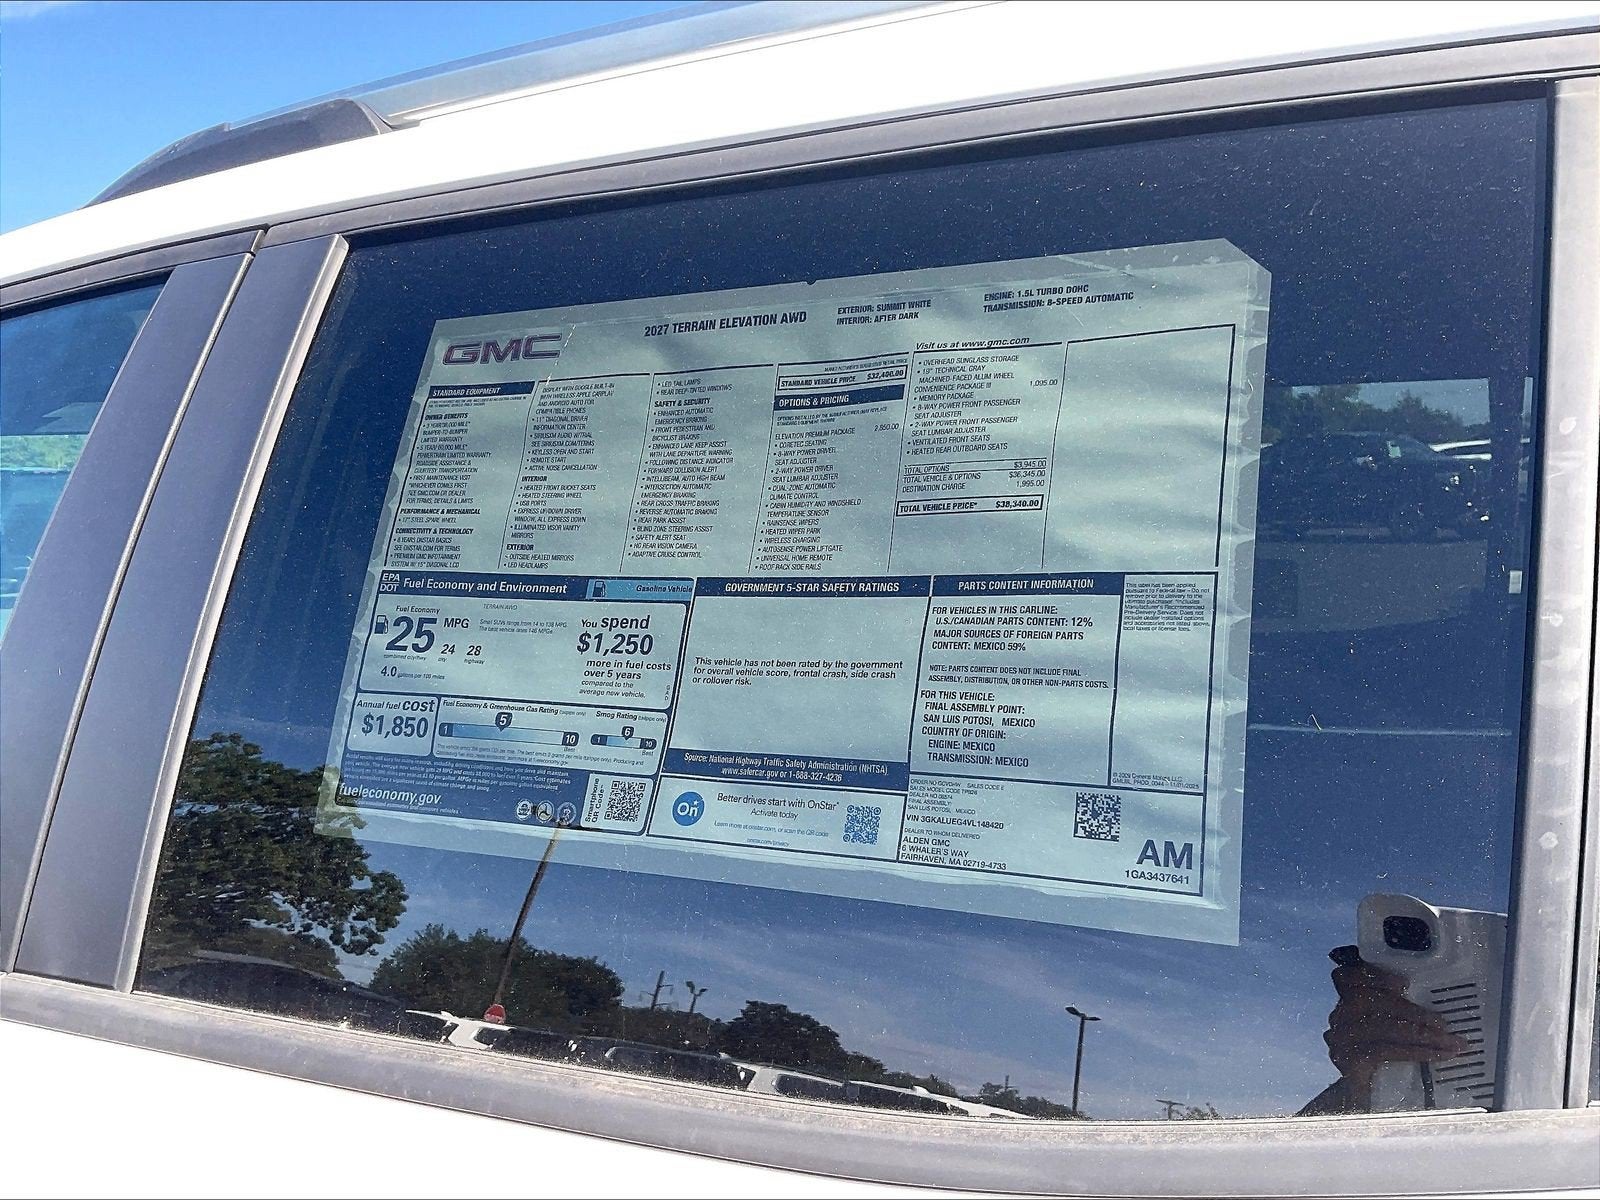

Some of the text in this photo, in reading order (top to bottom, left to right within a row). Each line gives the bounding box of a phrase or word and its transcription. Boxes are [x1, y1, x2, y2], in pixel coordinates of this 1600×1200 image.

[984, 284, 1089, 301] ENGINE: 1.5L TURBO DOHC
[837, 299, 931, 315] EXTERIOR: SUMMIT WHITE
[984, 291, 1134, 313] TRANSMISSION: 8-SPEED AUTOMATIC
[644, 311, 807, 336] 2027 TERRAIN ELEVATION AWD
[836, 311, 919, 326] INTERIOR: AFTER DARK
[442, 333, 562, 365] GMC
[961, 338, 1030, 349] www.gmc.com
[923, 354, 1018, 366] OVERHEAD SUNGLASS STORAGE
[867, 368, 904, 381] $32,400.00
[781, 375, 856, 388] STANDARD VEHICLE PRICE
[433, 387, 500, 397] STANDARD EQUIPMENT
[779, 394, 849, 406] OPTIONS & PRICING
[912, 434, 990, 446] VENTILATED FRONT SEATS
[1014, 460, 1046, 468] $3,945.00
[901, 474, 923, 483] TOTAL
[922, 474, 948, 482] VEHICLE
[953, 472, 981, 481] OPTIONS
[901, 482, 966, 493] DESTINATION CHARGE
[900, 504, 920, 512] TOTAL
[922, 503, 951, 512] VEHICLE
[995, 499, 1039, 509] $38,340.00
[382, 573, 399, 582] EPA
[380, 583, 399, 592] DOT
[403, 577, 567, 595] Fuel Economy and Environment
[636, 584, 694, 593] Gasoline Vehicle
[725, 582, 899, 593] GOVERNMENT 5-STAR SAFETY RATINGS
[958, 579, 1093, 590] PARTS CONTENT INFORMATION
[395, 604, 439, 616] Fuel Economy
[932, 606, 1058, 615] FOR VEHICLES IN THIS CARLINE:
[444, 618, 469, 629] MPG
[581, 615, 650, 630] You spend
[936, 617, 1093, 626] U.S./CANADIAN PARTS CONTENT: 12%
[386, 616, 437, 653] 25
[440, 644, 456, 655] 24
[576, 632, 653, 656] $1,250
[466, 645, 482, 656] 28
[586, 659, 671, 670] more in fuel costs
[694, 656, 903, 671] This vehicle has not been rated by the government
[381, 666, 397, 677] 4.0
[357, 700, 435, 712] Annual fuel cost
[443, 699, 455, 708] Fuel
[455, 700, 482, 711] Economy
[489, 702, 525, 712] Greenhouse
[526, 705, 538, 713] Gas
[538, 706, 559, 716] Rating
[500, 714, 508, 726] 5
[596, 710, 615, 720] Smog
[616, 712, 637, 722] Rating
[362, 712, 429, 738] $1,850
[566, 734, 576, 744] 10
[928, 740, 996, 751] ENGINE: MEXICO
[928, 752, 1029, 767] TRANSMISSION: MEXICO
[721, 767, 779, 779] www.safercar.gov
[789, 771, 842, 782] 1-888-327-4236
[585, 778, 599, 822] Smartphone
[717, 792, 743, 803] Better
[742, 794, 766, 805] drives
[767, 795, 786, 806] start
[788, 797, 806, 807] with
[677, 802, 699, 817] On
[750, 808, 798, 822] Activate today
[906, 814, 919, 823] VIN
[903, 836, 950, 848] ALDEN GMC
[1136, 839, 1193, 870] AM
[900, 853, 1006, 870] FAIRHAVEN, MA 02719-4733
[1125, 870, 1189, 884] 1GA3437641
